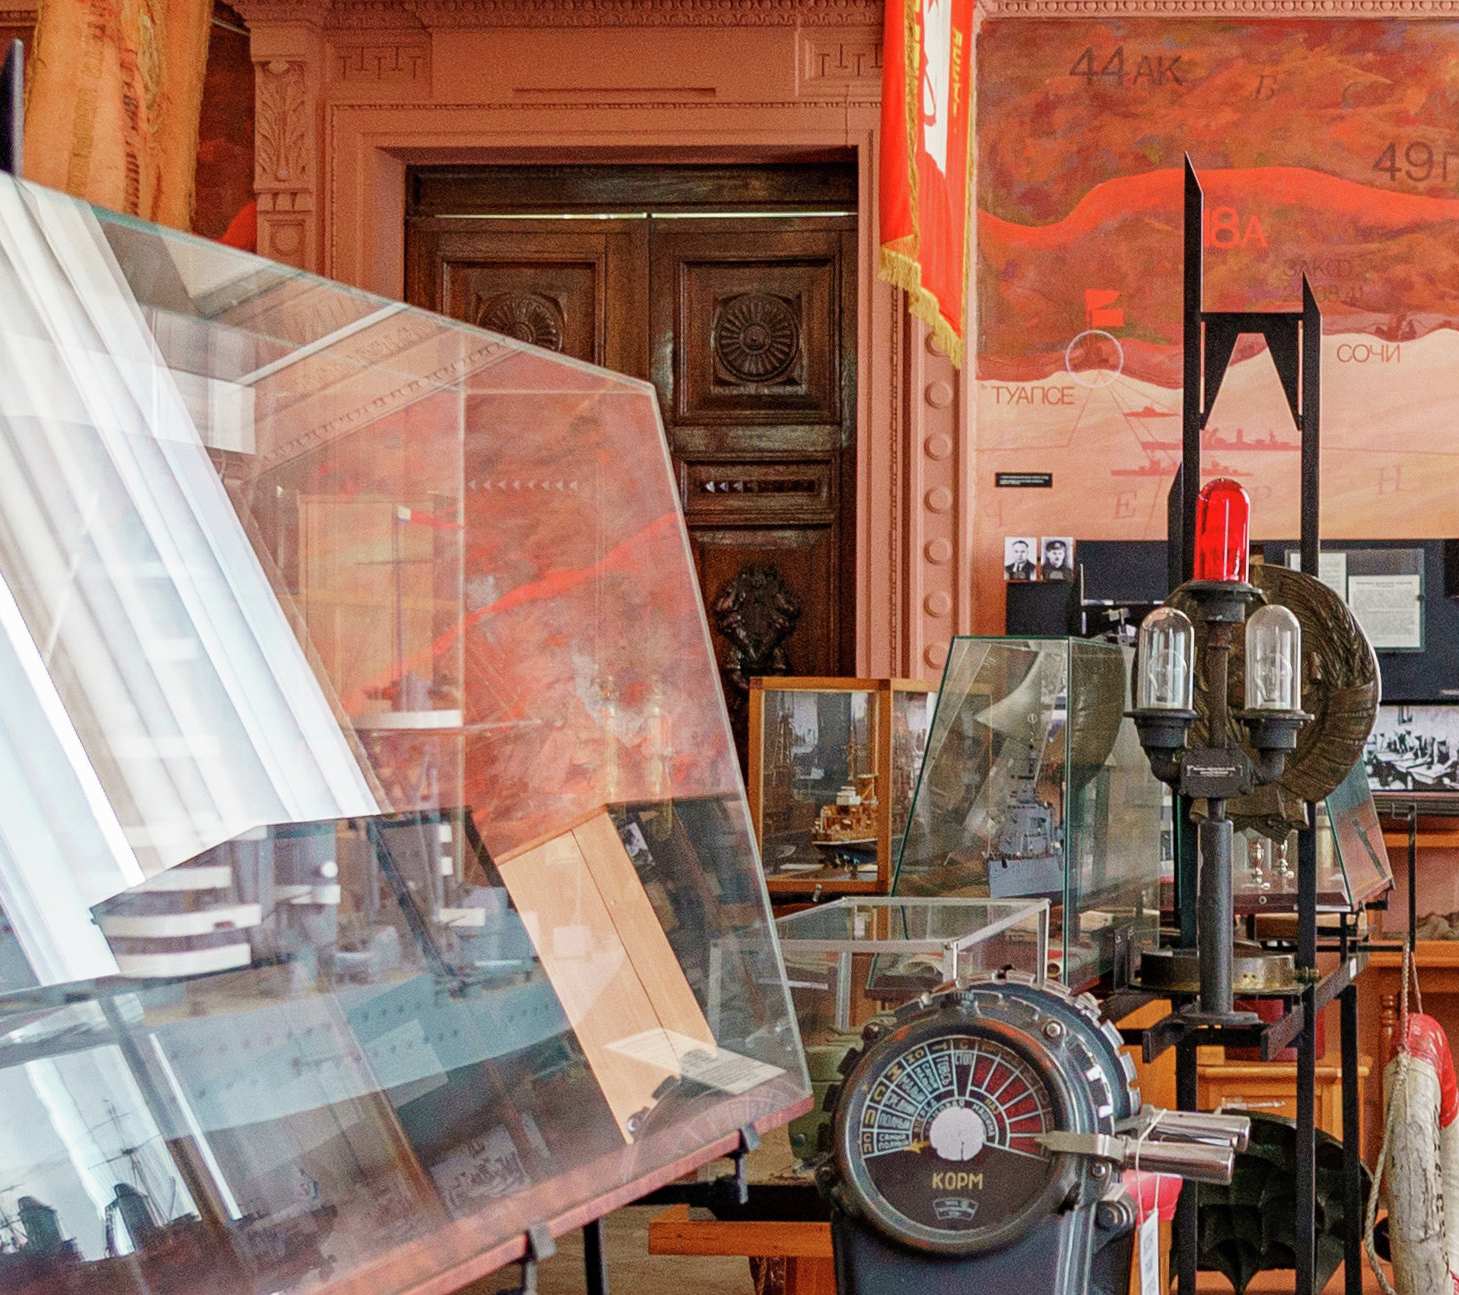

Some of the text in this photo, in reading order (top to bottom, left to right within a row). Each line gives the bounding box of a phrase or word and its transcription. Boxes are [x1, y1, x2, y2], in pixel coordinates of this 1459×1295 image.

[1336, 343, 1402, 365] СОЧИ
[991, 385, 1076, 406] ТУАПСЕ
[931, 1170, 985, 1191] КОРМ
